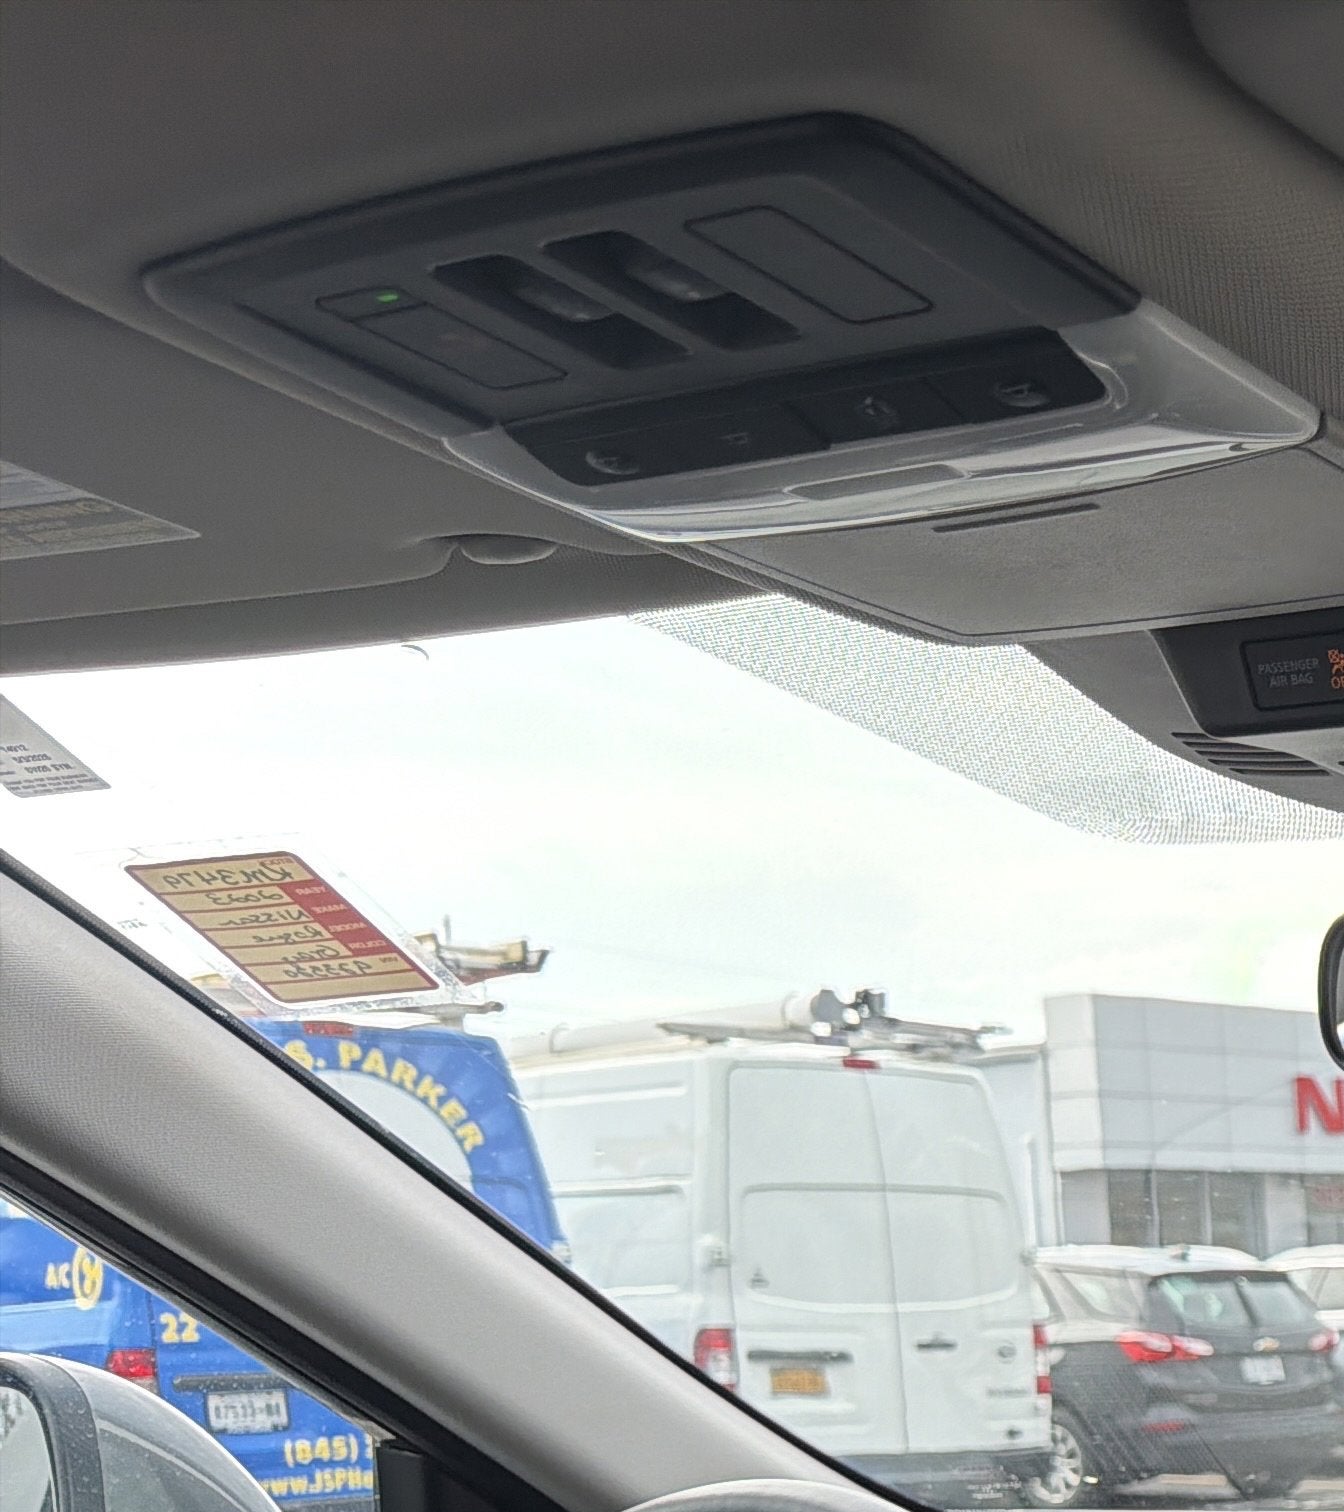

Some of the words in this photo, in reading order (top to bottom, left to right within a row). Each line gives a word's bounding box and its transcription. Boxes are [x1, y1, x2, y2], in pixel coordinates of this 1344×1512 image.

[1257, 658, 1319, 675] PASSENGER
[1269, 674, 1289, 688] AIR
[1291, 672, 1313, 686] BAG
[338, 1041, 485, 1151] PARKER
[160, 1313, 200, 1343] 22
[284, 1434, 359, 1469] (845)
